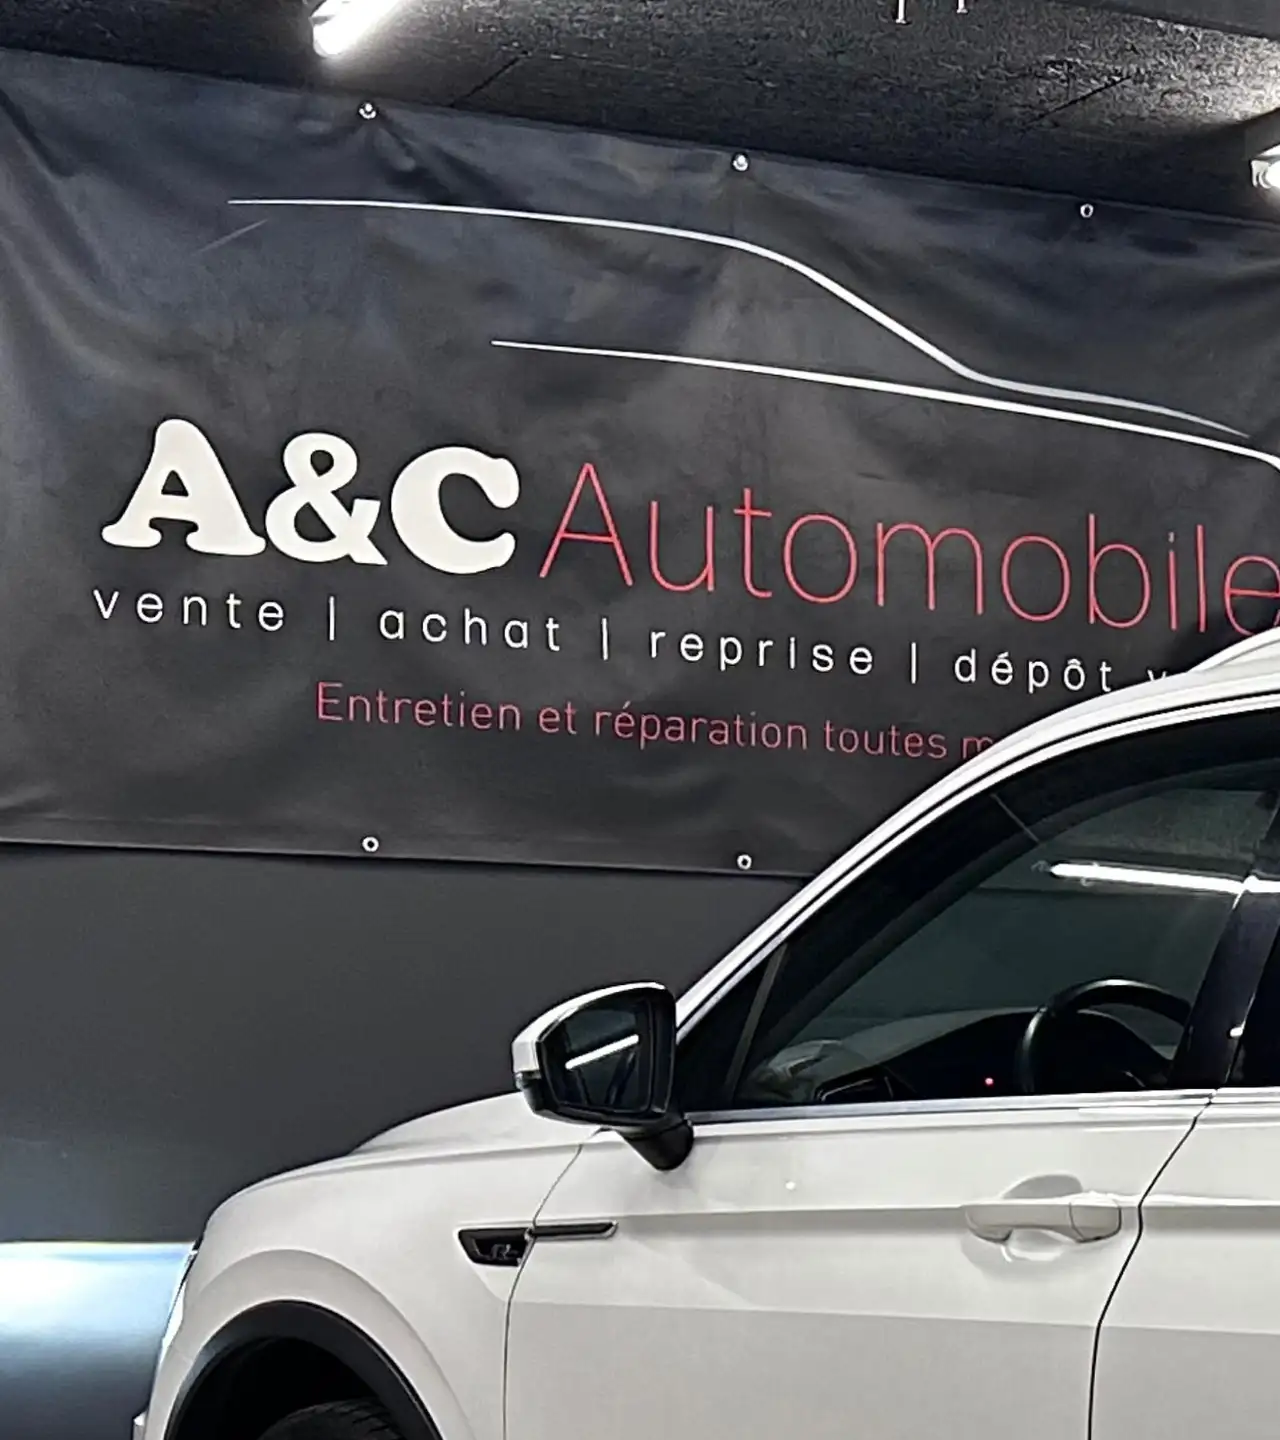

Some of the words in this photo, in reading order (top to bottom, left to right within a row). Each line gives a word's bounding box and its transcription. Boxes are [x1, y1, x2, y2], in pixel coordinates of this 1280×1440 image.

[101, 418, 520, 575] A&C
[93, 588, 286, 632] vente
[379, 609, 561, 652] achat
[649, 630, 873, 676] reprise
[954, 647, 1113, 693] dépôt
[316, 681, 521, 733] Entretien
[537, 703, 577, 735] et
[594, 700, 808, 750] réparation
[823, 720, 947, 760] toutes
